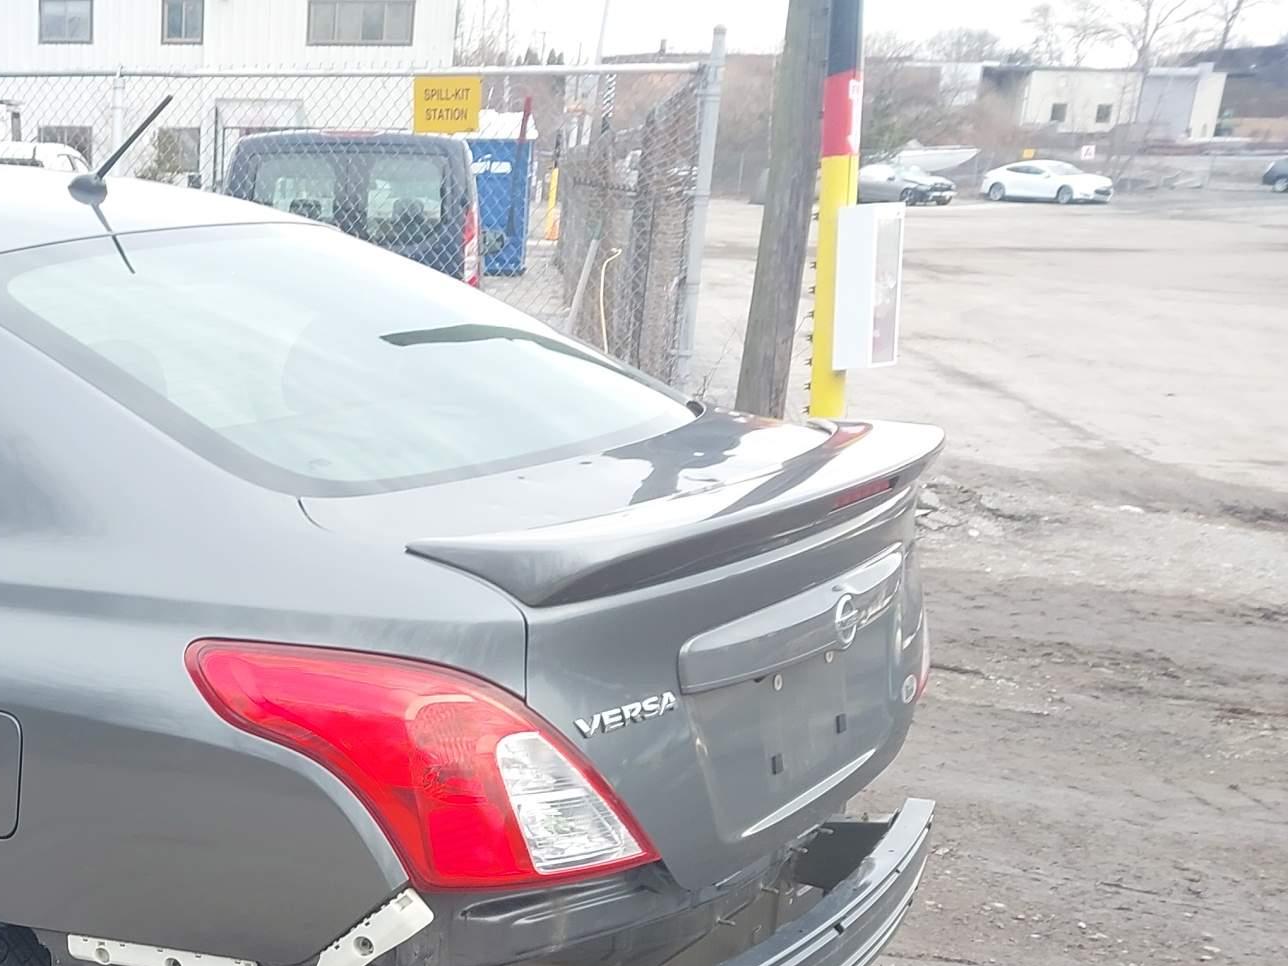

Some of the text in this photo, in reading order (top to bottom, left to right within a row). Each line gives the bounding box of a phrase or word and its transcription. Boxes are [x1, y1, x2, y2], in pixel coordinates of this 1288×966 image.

[423, 87, 471, 101] SPILL-KIT
[425, 107, 468, 120] STATION
[573, 691, 677, 737] VERSA
